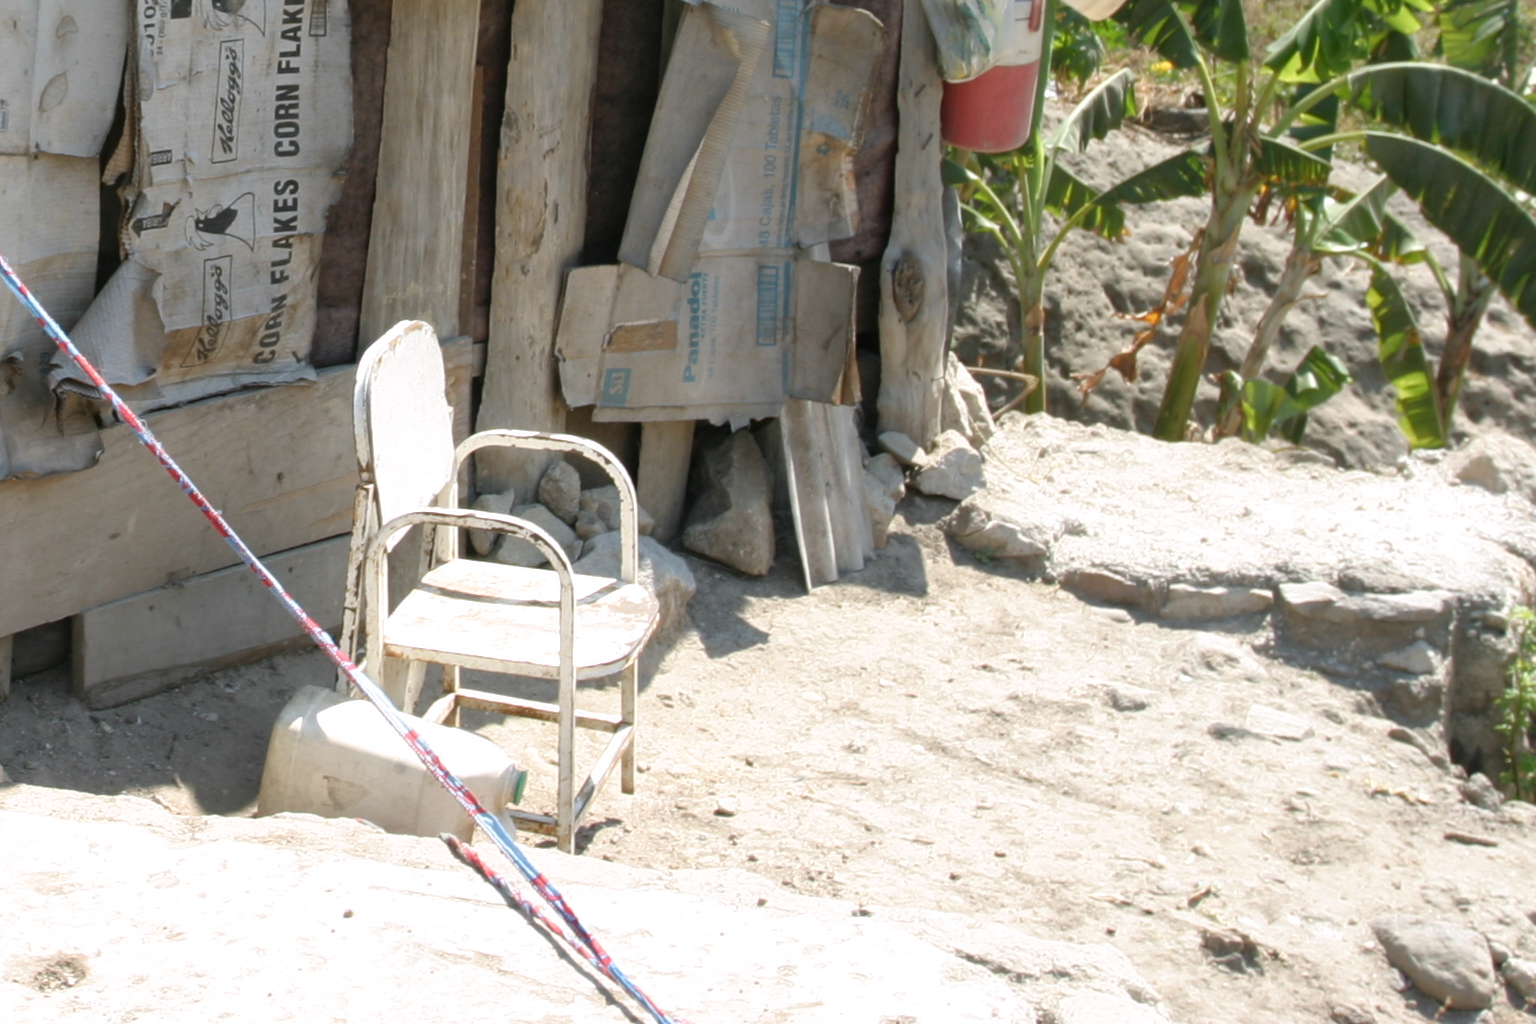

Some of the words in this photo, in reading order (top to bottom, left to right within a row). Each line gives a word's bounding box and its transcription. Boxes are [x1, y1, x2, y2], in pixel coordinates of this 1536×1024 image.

[217, 46, 241, 154] Kellogg's
[274, 84, 300, 157] CORN
[765, 95, 782, 150] Tabletas
[759, 184, 776, 227] Cajas,
[763, 155, 777, 178] 100
[196, 265, 228, 362] Kellogg's
[252, 293, 288, 365] CORN
[270, 180, 299, 285] FLAKES
[682, 272, 703, 383] Panadol
